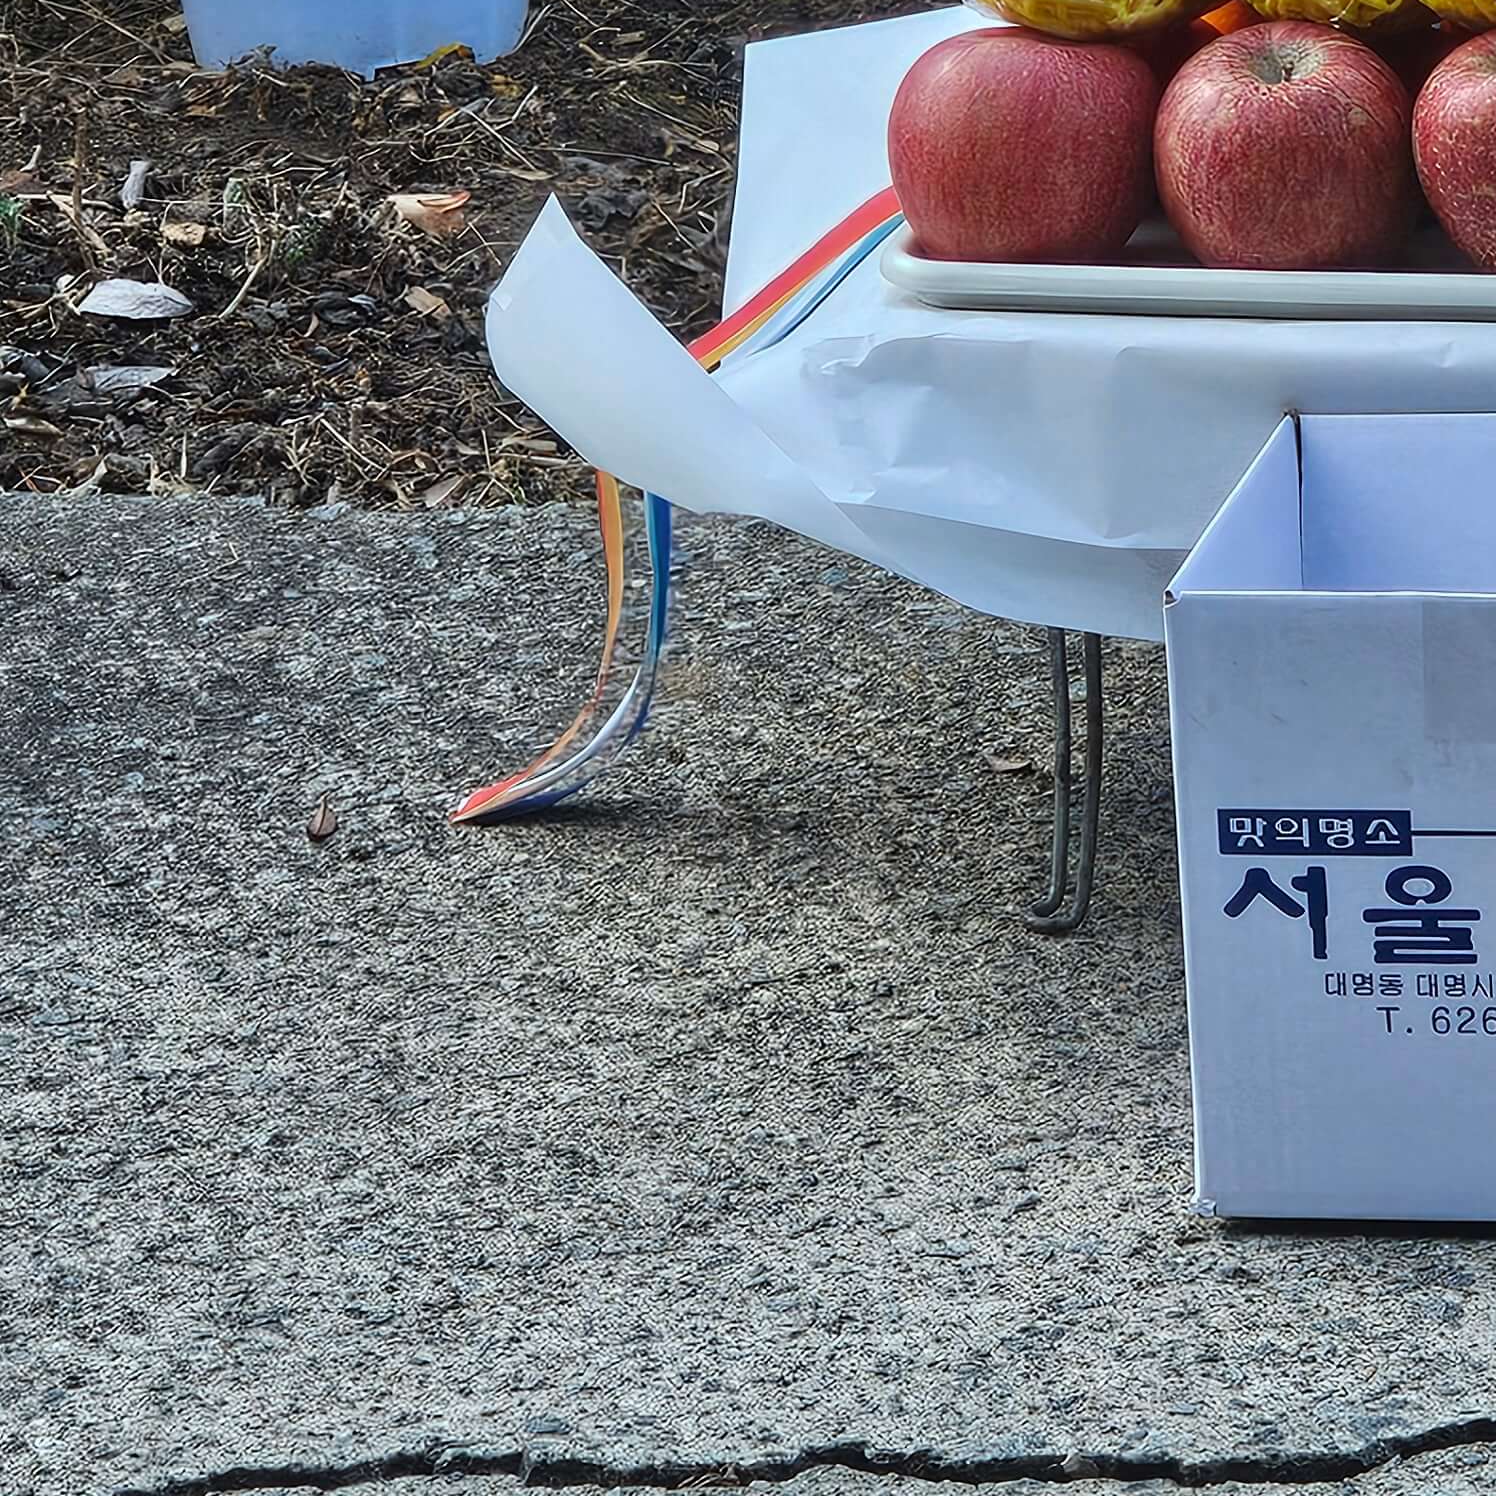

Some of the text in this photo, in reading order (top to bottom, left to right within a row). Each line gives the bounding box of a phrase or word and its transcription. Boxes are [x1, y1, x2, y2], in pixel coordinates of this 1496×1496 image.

[1229, 817, 1401, 849] 맛의명소
[1325, 972, 1403, 997] 대명동
[1376, 1006, 1413, 1034] T.
